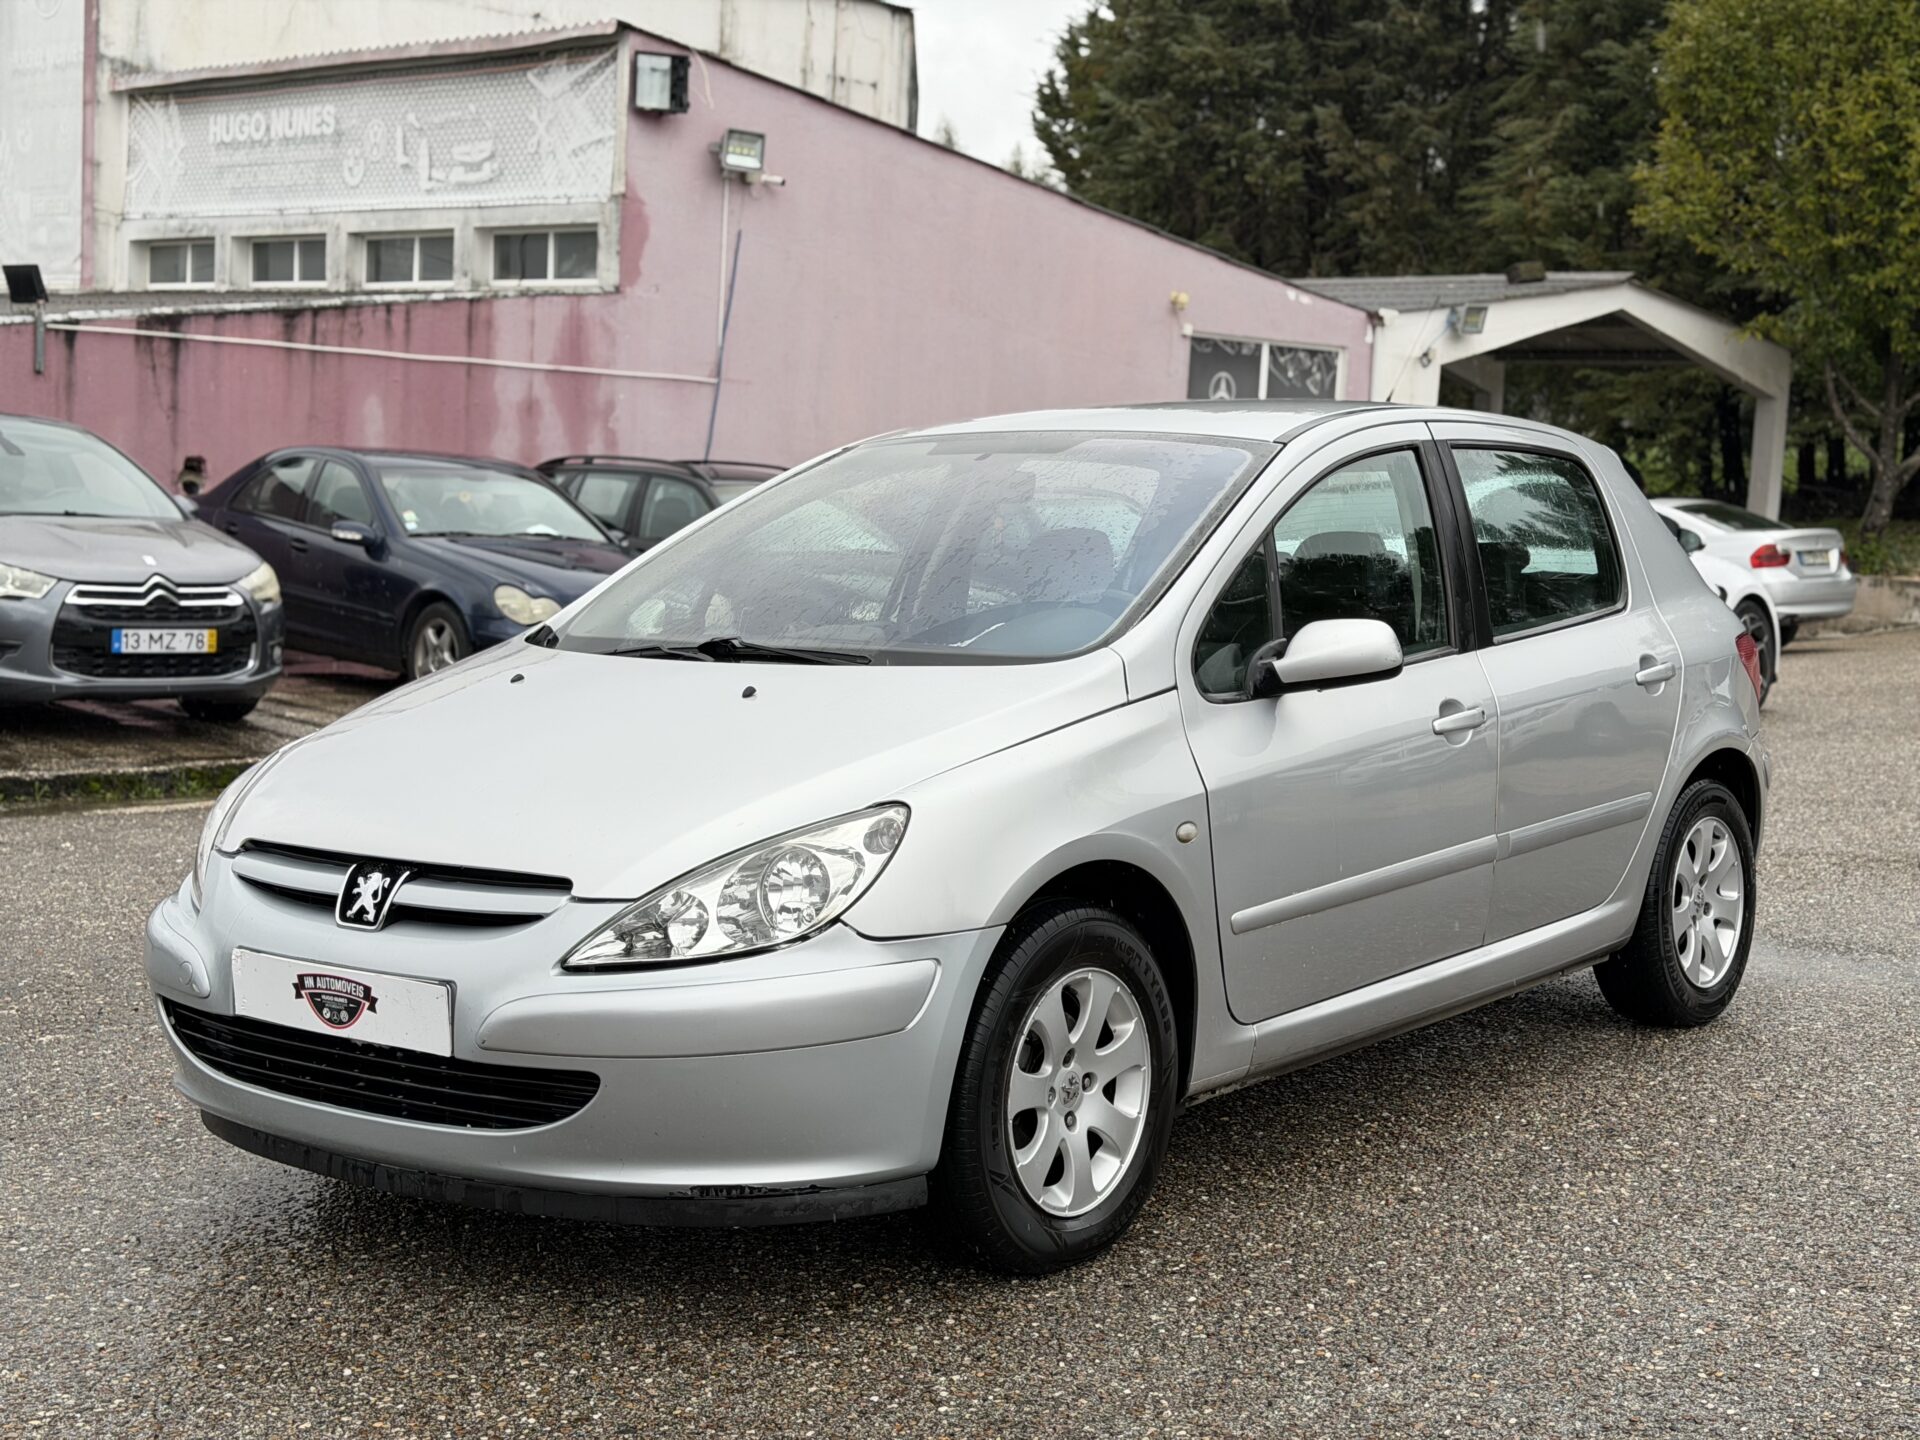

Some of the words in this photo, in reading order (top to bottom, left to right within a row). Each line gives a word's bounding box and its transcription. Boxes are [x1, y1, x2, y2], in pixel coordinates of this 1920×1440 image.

[209, 112, 267, 145] HUGO
[271, 105, 336, 139] NUNES
[304, 976, 315, 989] HN
